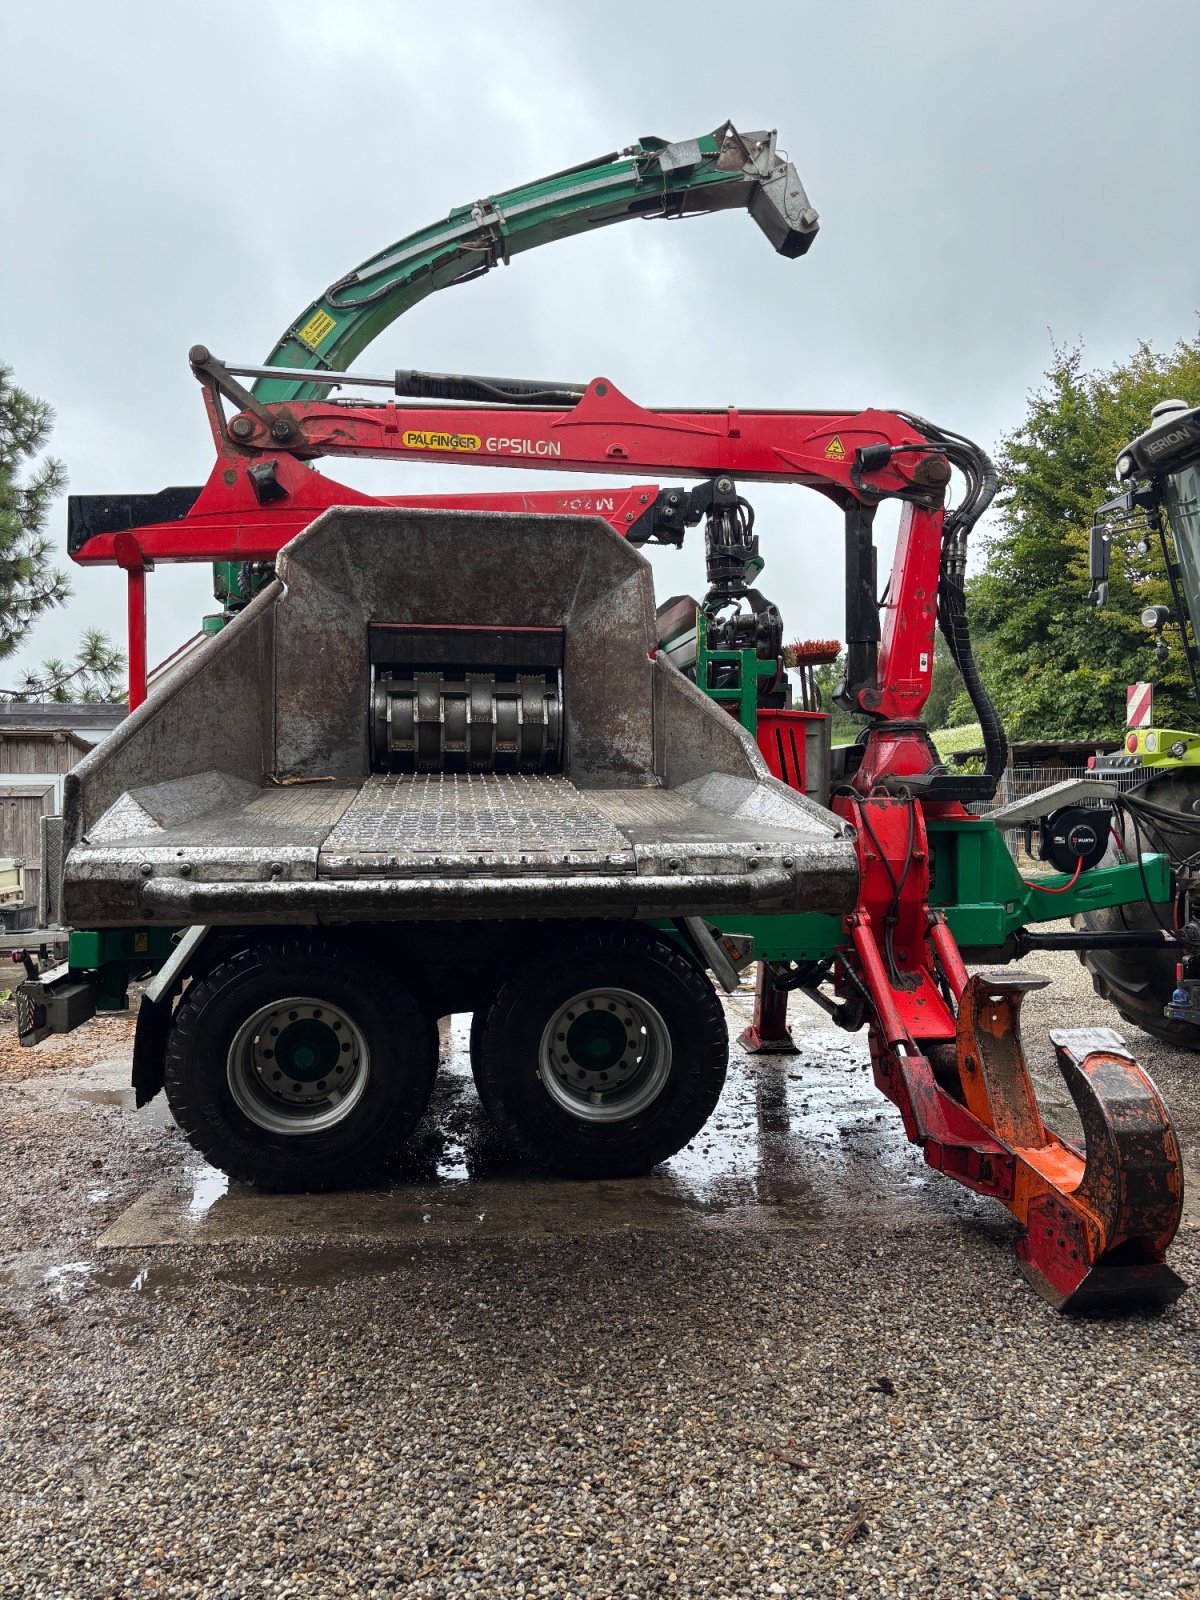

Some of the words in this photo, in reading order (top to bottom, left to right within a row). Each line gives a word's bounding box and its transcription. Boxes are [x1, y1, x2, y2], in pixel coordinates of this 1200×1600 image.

[407, 432, 477, 449] PALFINGER
[486, 437, 560, 456] EPSILON
[1143, 427, 1191, 457] XERION
